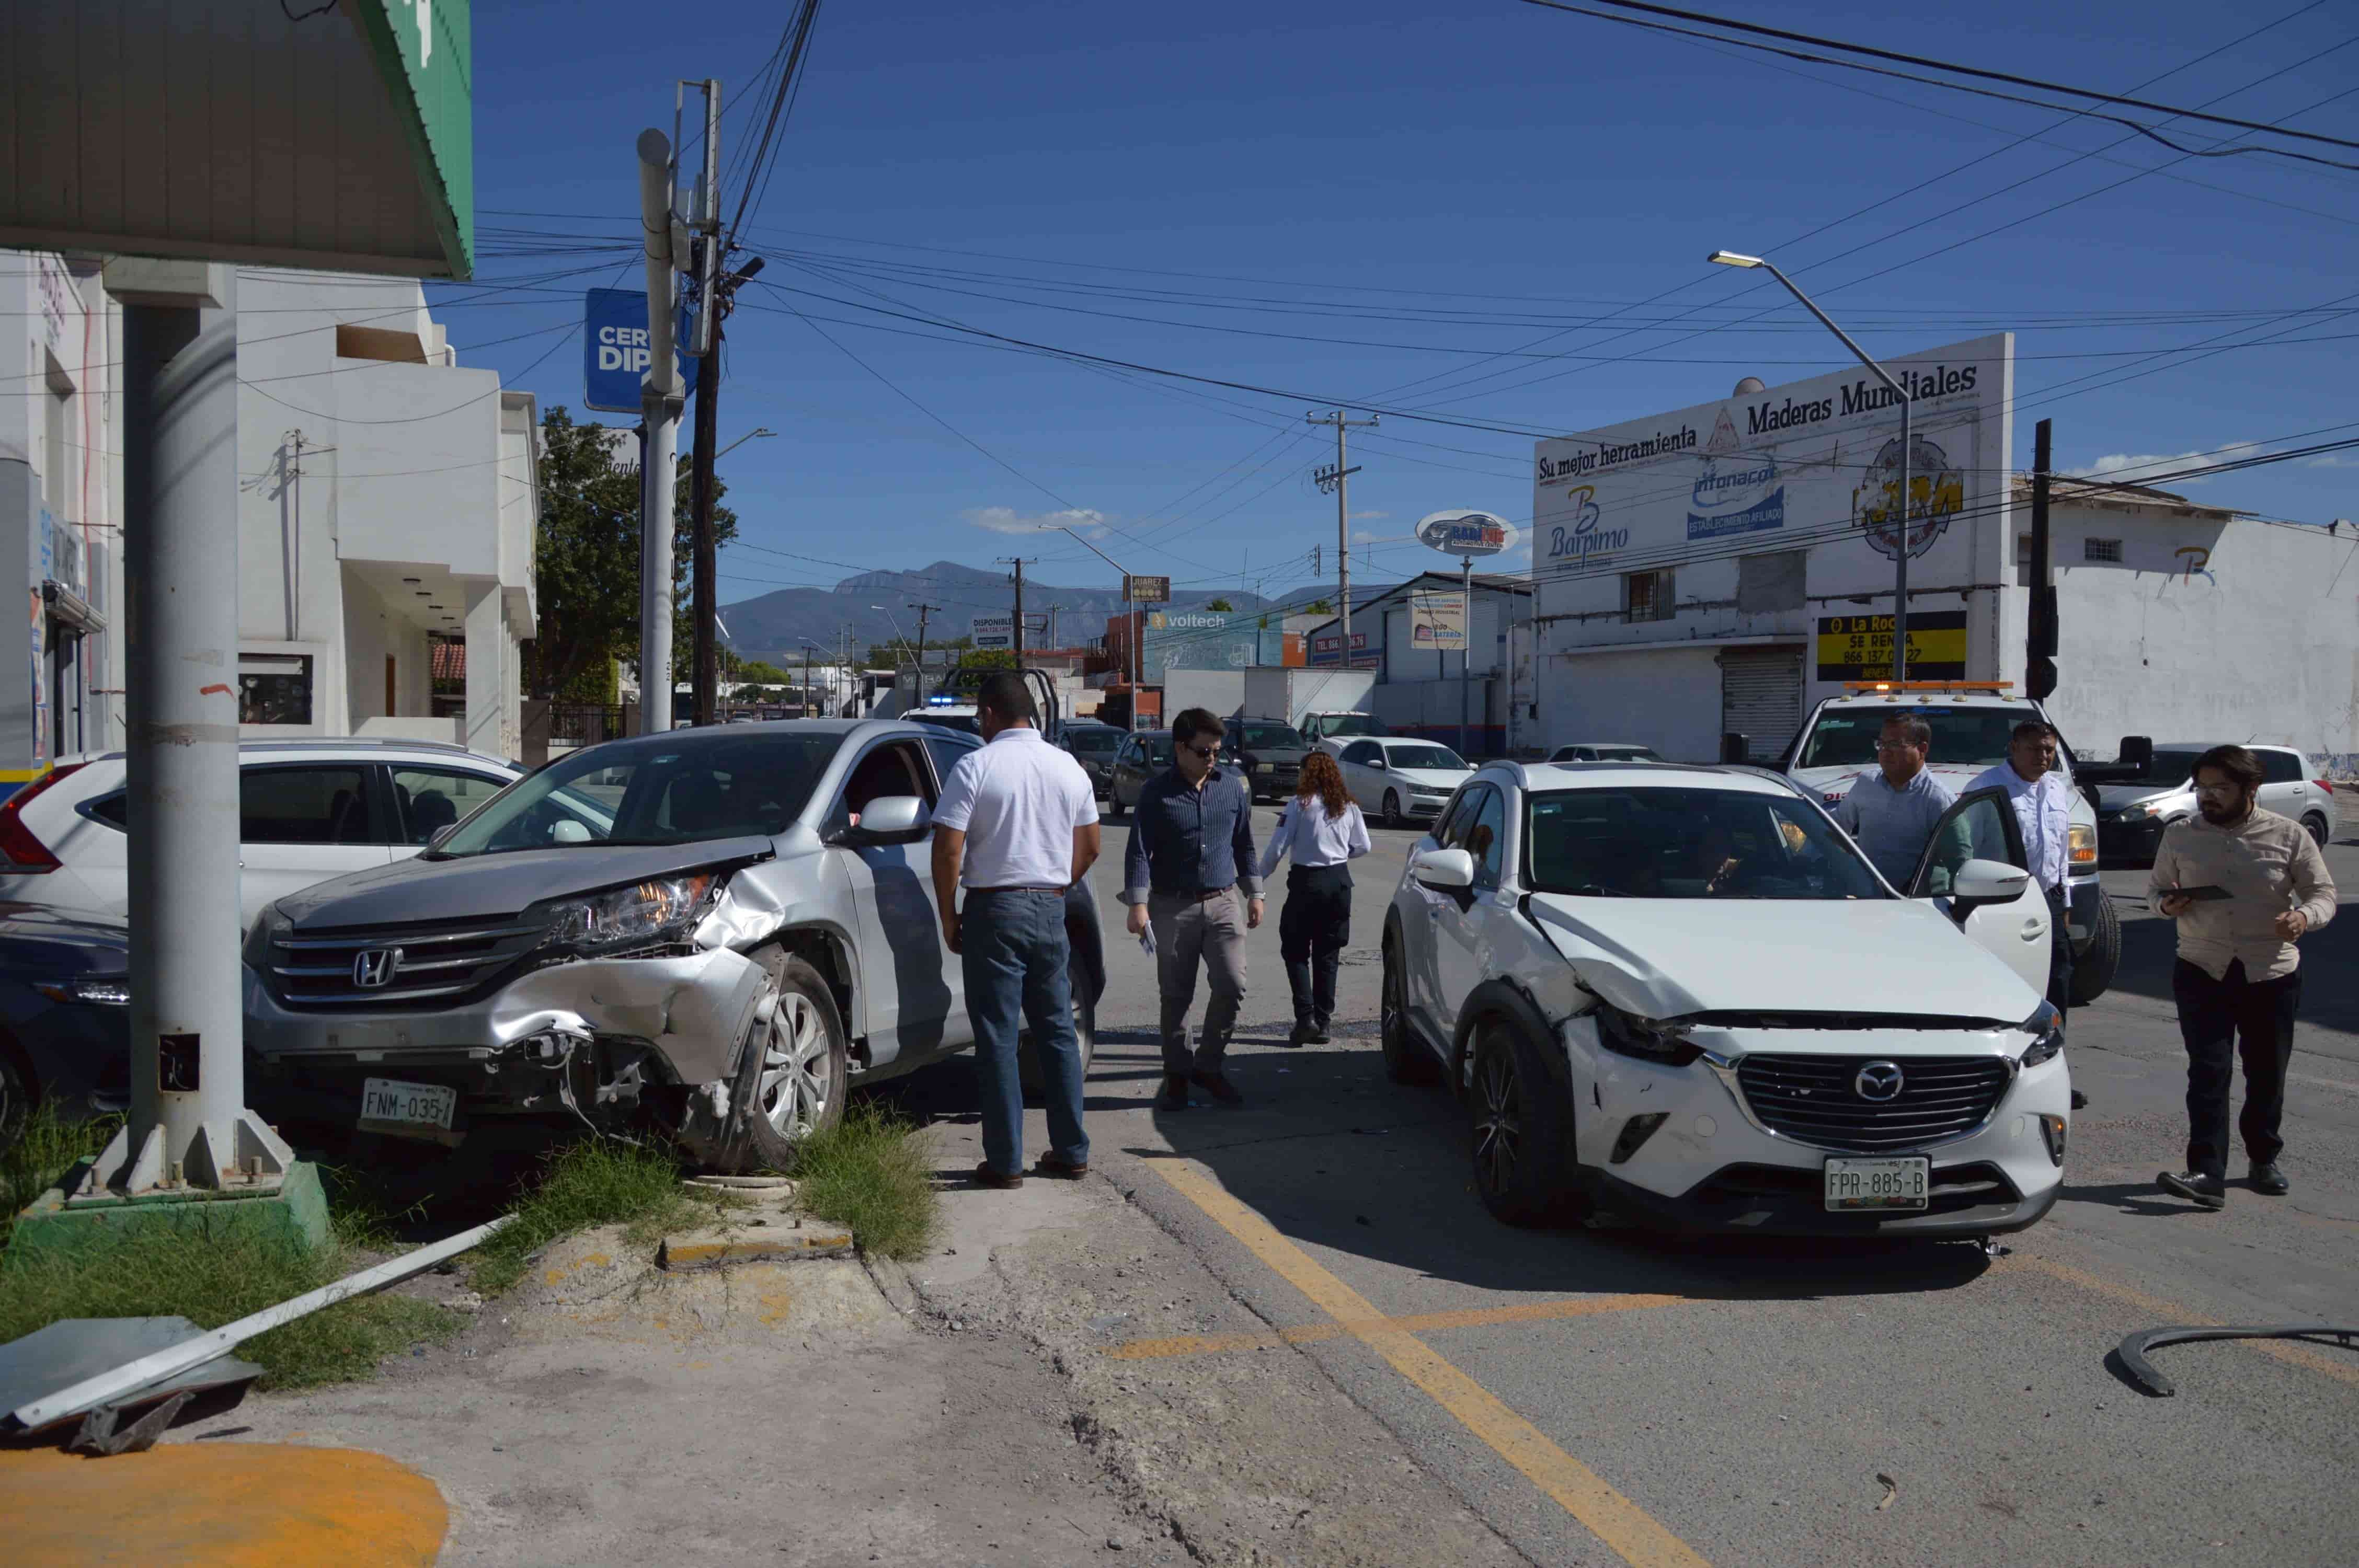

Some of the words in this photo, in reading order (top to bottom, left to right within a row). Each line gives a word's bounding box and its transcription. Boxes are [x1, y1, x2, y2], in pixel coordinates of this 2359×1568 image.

[599, 326, 650, 346] CER
[598, 345, 651, 372] DIP
[1747, 397, 1832, 435] Maderas
[1839, 365, 1977, 416] Mundiales
[1539, 456, 1555, 479] Su
[1558, 449, 1597, 476] mejor
[1599, 422, 1696, 467] herramienta
[1548, 526, 1628, 570] Barpimo
[974, 618, 1013, 627] DISPONIBLE
[1169, 614, 1224, 628] voltech
[1851, 618, 1866, 632] La
[1871, 616, 1895, 631] Roc
[1849, 635, 1864, 649] SE
[1871, 633, 1914, 648] RENA
[1829, 1172, 1924, 1195] FPR-885-B
